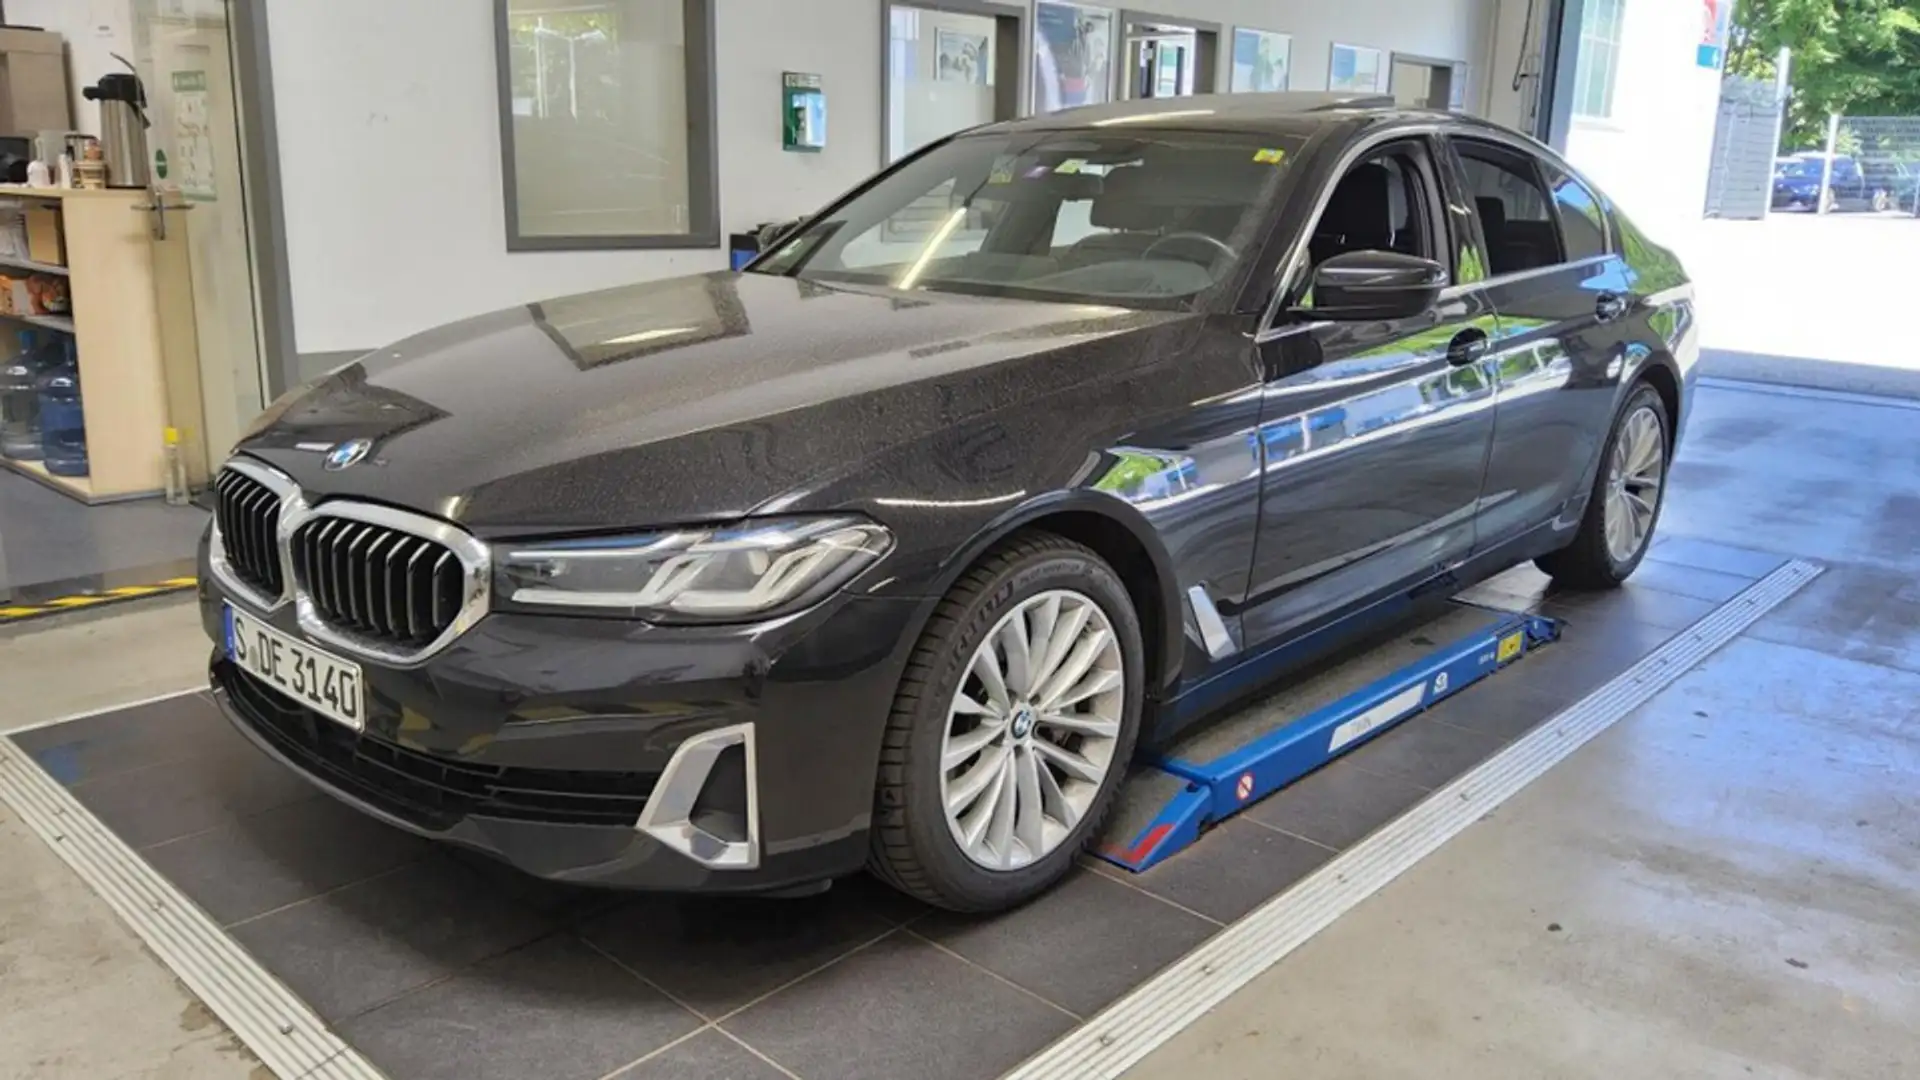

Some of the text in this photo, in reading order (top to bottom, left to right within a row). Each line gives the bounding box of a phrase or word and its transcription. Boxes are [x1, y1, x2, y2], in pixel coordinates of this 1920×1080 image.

[235, 617, 247, 661] S
[257, 631, 286, 686] DE
[291, 649, 357, 718] 3140
